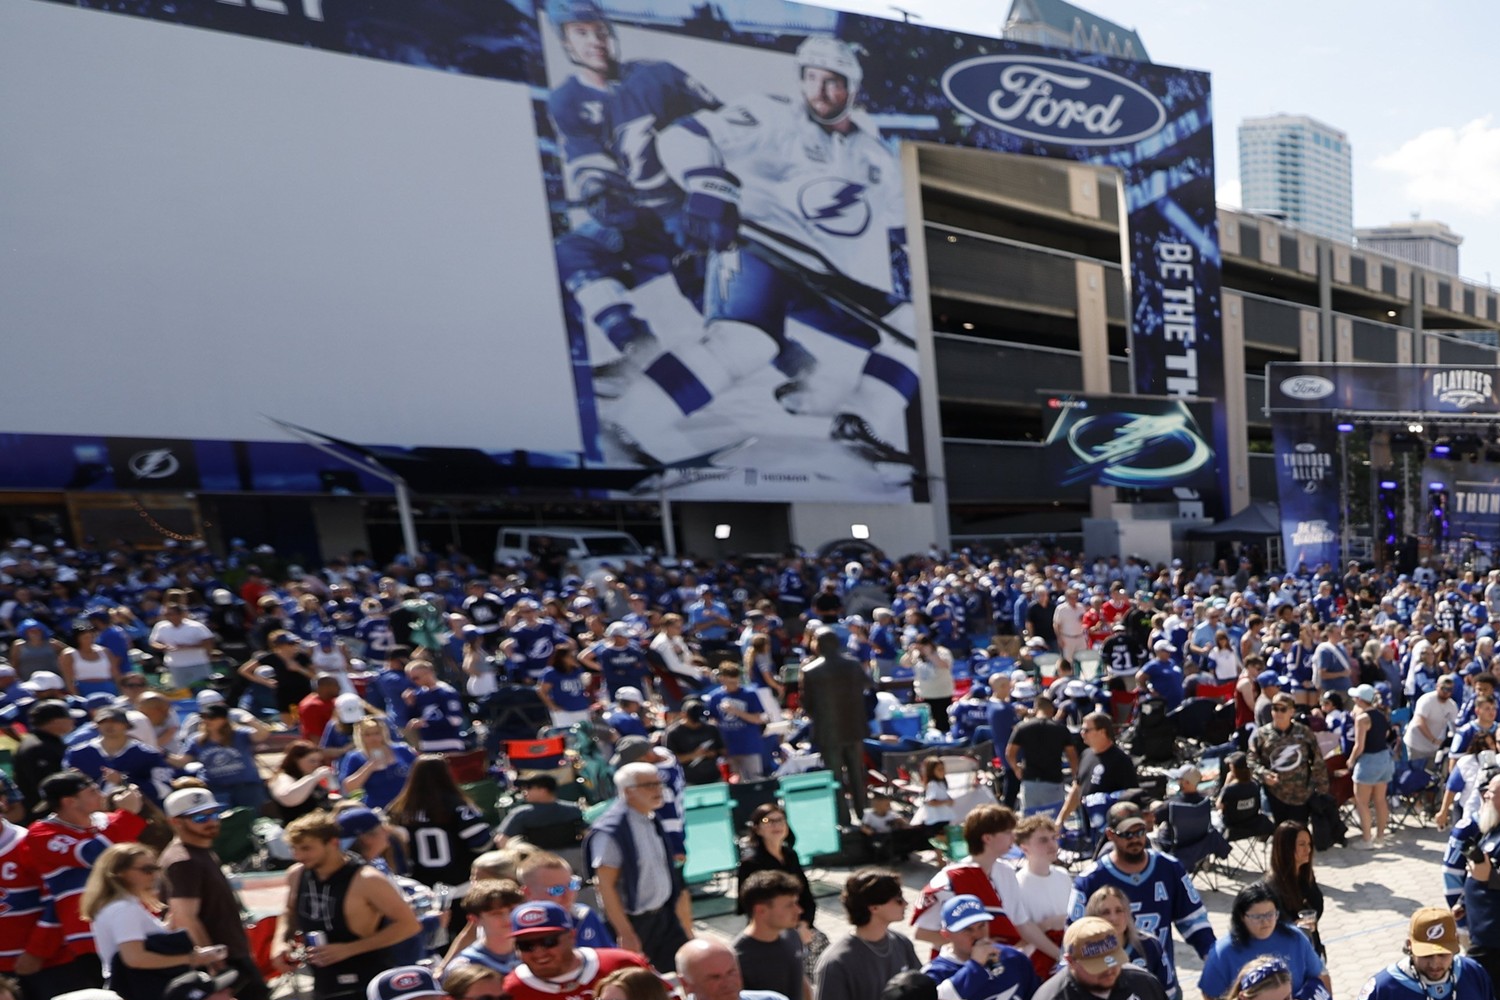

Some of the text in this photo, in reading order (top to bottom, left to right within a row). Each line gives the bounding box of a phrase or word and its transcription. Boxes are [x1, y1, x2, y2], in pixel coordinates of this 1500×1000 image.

[988, 65, 1125, 135] Ford
[1159, 242, 1193, 281] BE
[1162, 285, 1196, 341] THE
[1433, 370, 1493, 397] PLAYOFFS
[1283, 454, 1331, 467] THUNDER
[1292, 466, 1325, 480] ALLEY
[1, 861, 18, 881] C
[1154, 881, 1169, 902] A
